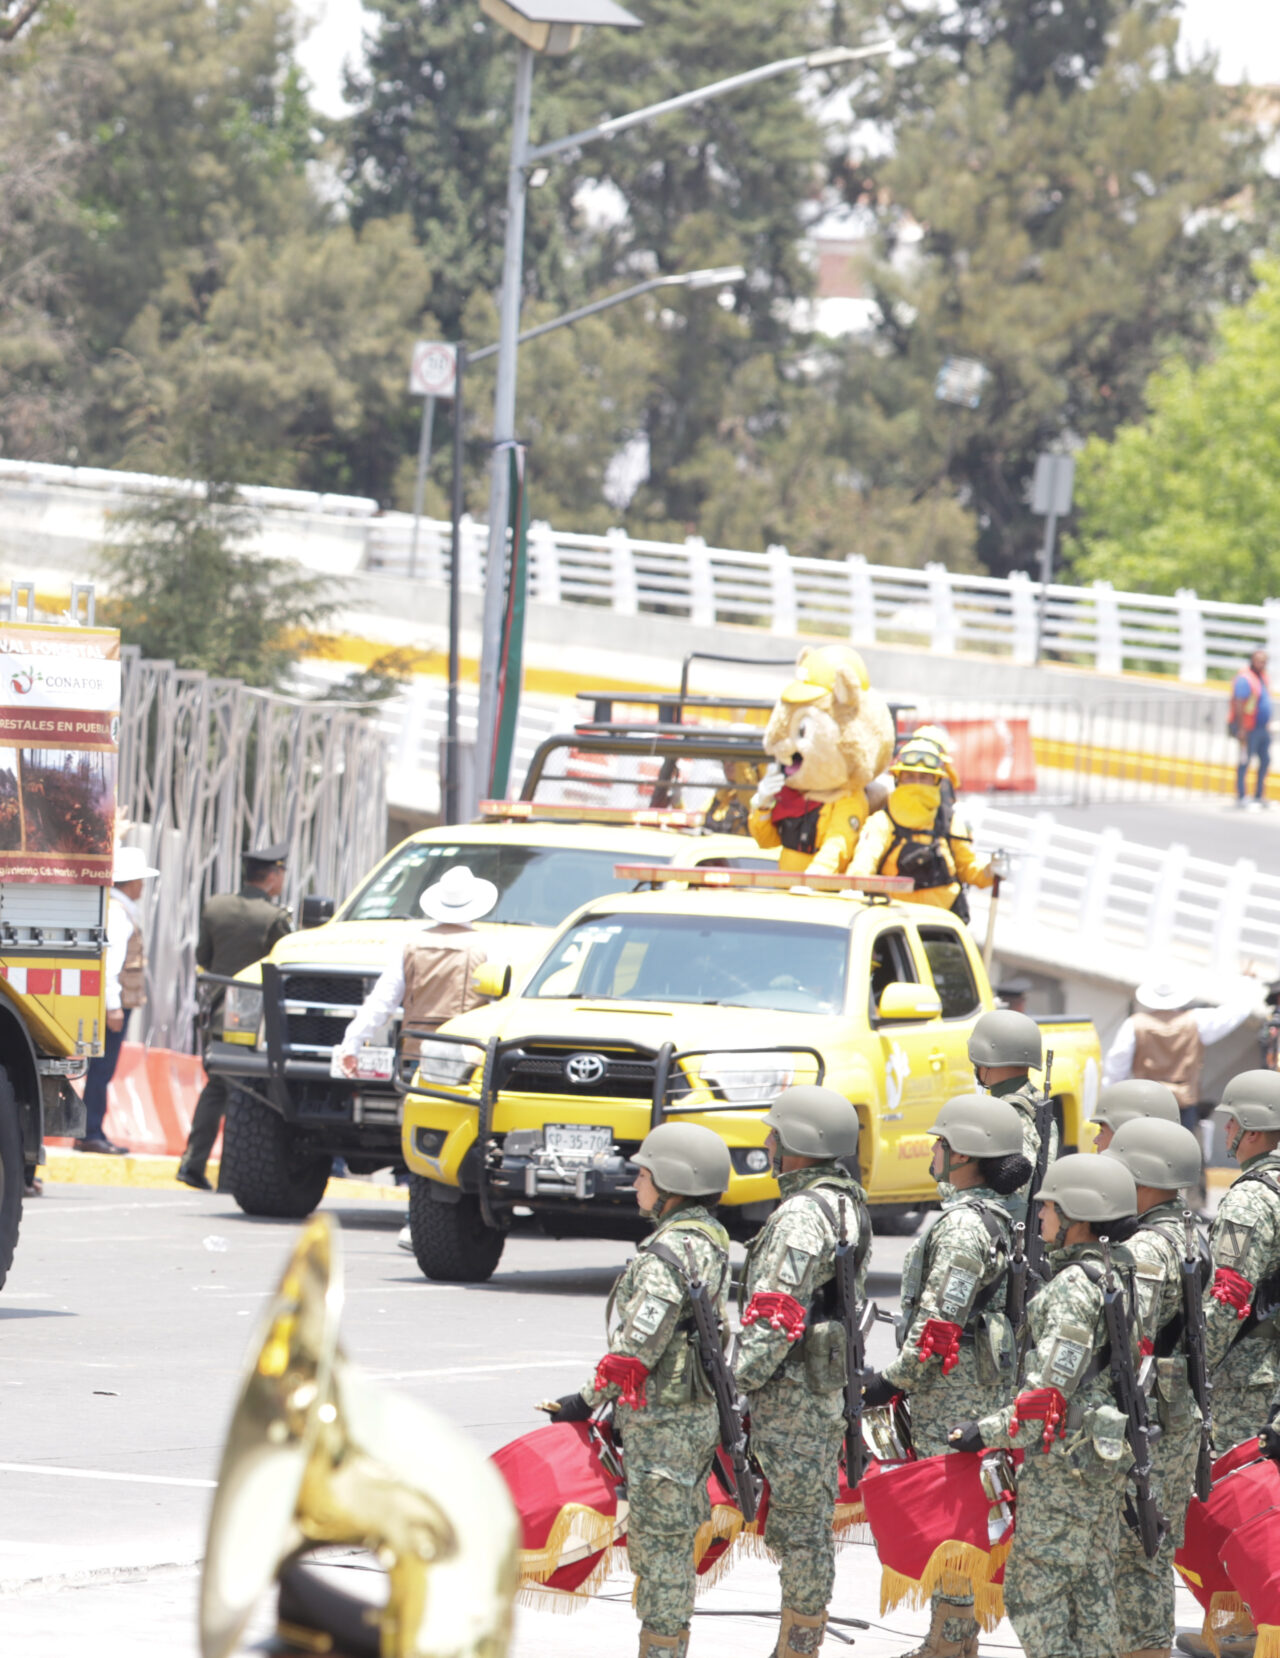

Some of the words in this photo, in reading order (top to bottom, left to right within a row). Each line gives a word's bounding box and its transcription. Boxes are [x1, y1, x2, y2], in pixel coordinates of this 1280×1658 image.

[31, 641, 106, 659] FORESTAL
[45, 676, 104, 690] CONAFOR
[57, 720, 73, 732] EN
[76, 721, 110, 734] PUEBLA
